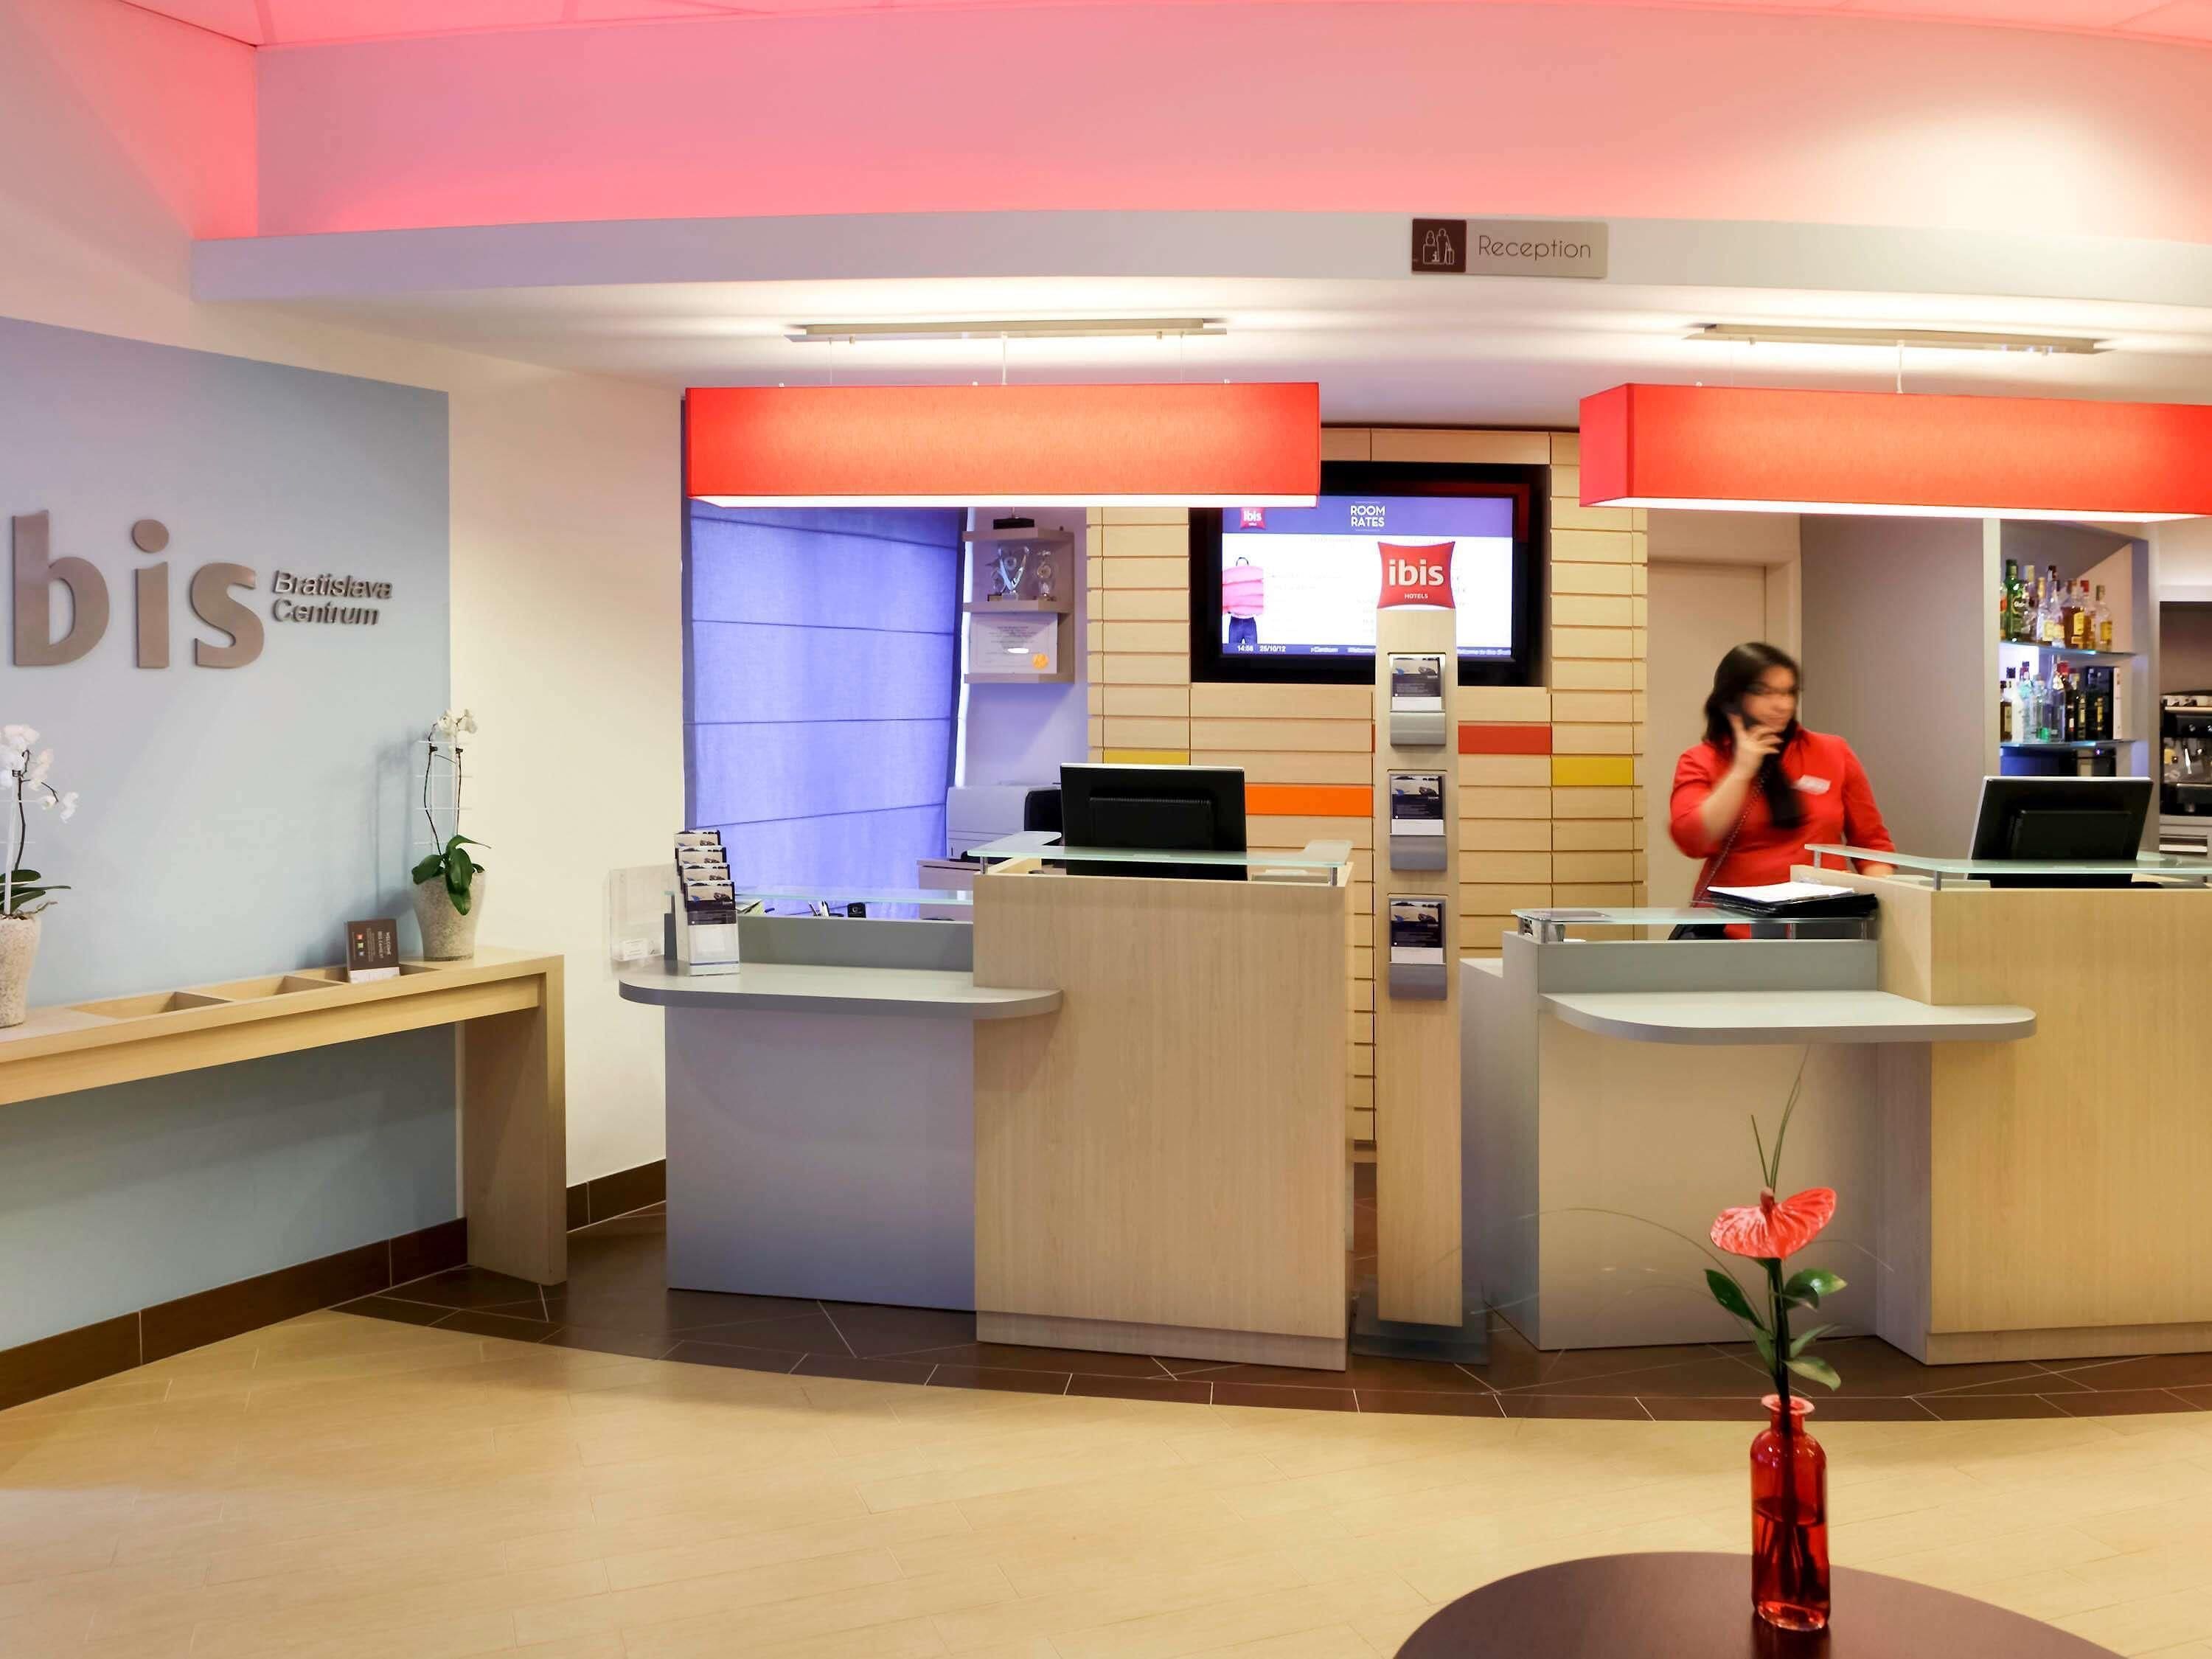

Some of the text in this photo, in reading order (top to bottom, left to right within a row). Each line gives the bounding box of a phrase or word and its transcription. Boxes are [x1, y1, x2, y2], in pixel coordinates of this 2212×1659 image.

[1478, 234, 1592, 261] Reception
[1243, 510, 1262, 522] ibis
[1350, 505, 1385, 517] ROOM
[1350, 517, 1385, 528] RATES
[272, 569, 394, 600] Bratislava
[1388, 558, 1444, 587] ibis
[272, 597, 382, 626] Centrum
